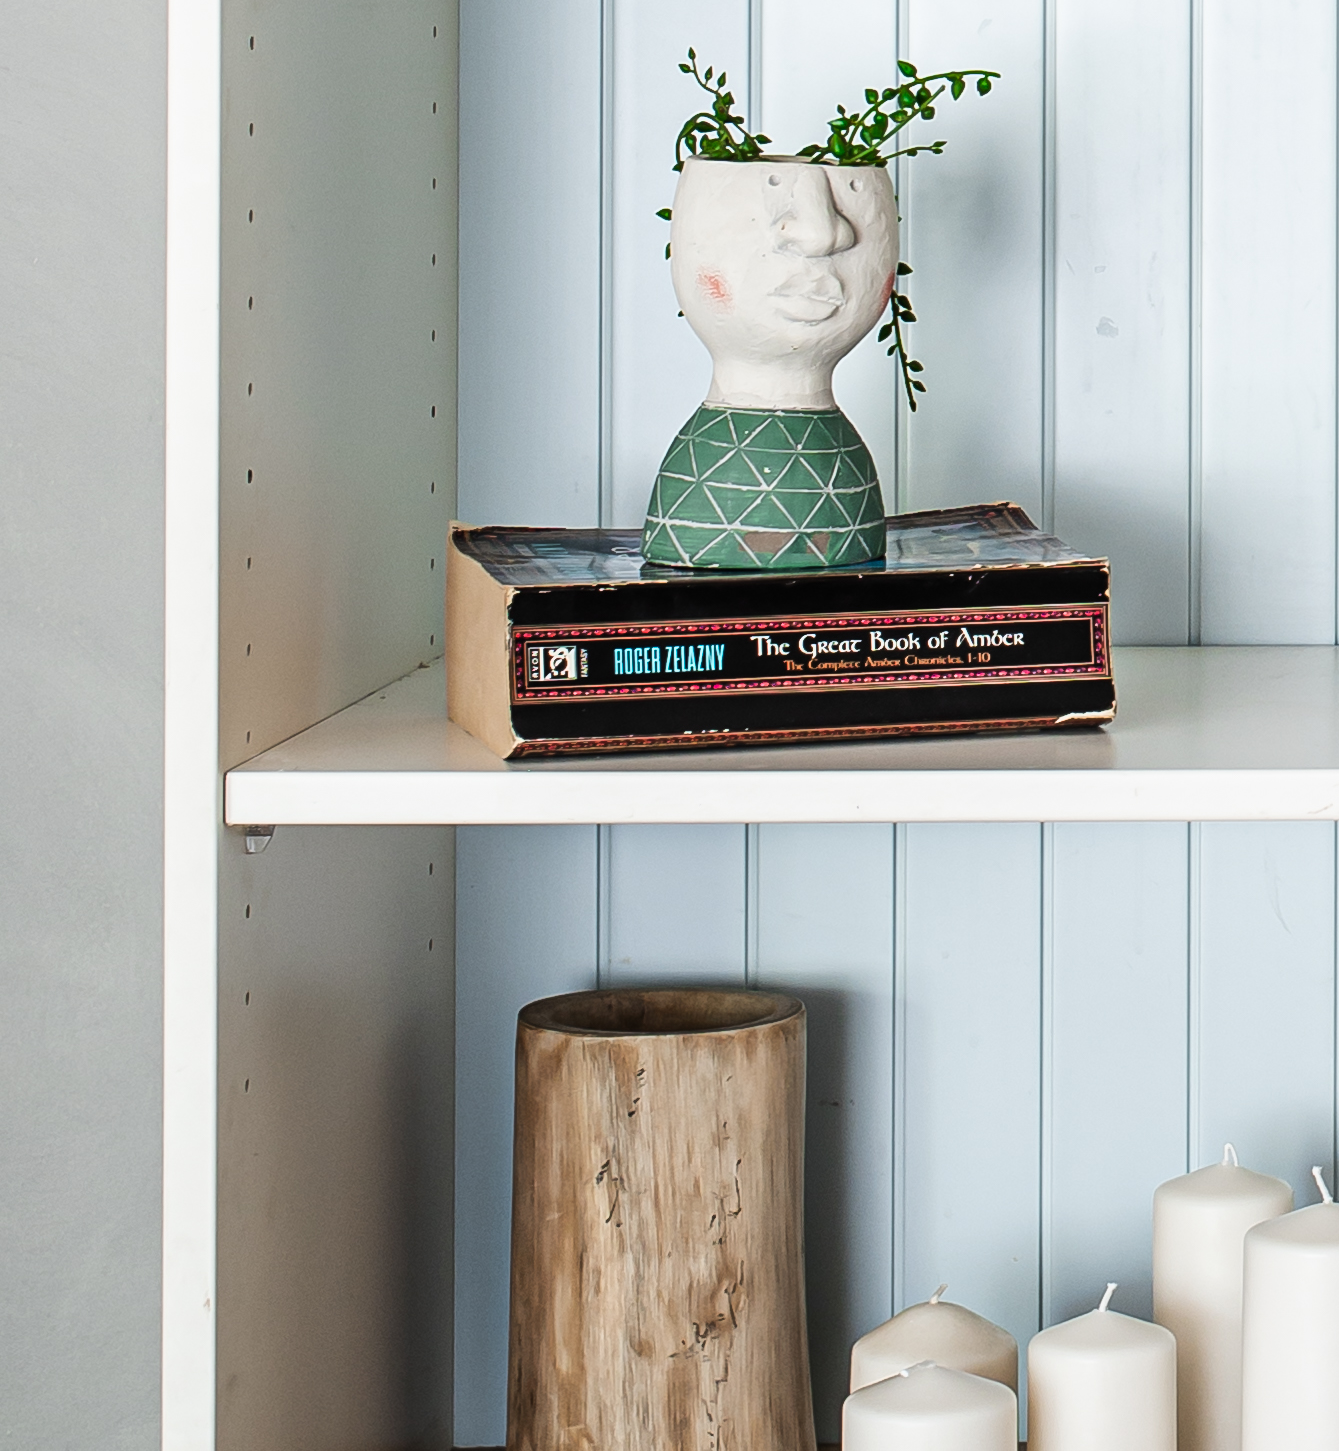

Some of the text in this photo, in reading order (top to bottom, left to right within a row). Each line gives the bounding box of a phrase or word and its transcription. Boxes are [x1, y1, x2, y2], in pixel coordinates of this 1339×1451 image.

[750, 635, 790, 657] The
[870, 630, 920, 653] Book
[928, 631, 949, 649] of
[956, 627, 1025, 648] Amber
[614, 644, 725, 675] ROGER ZELAZNY
[784, 659, 803, 671] The
[808, 657, 860, 672] Complete
